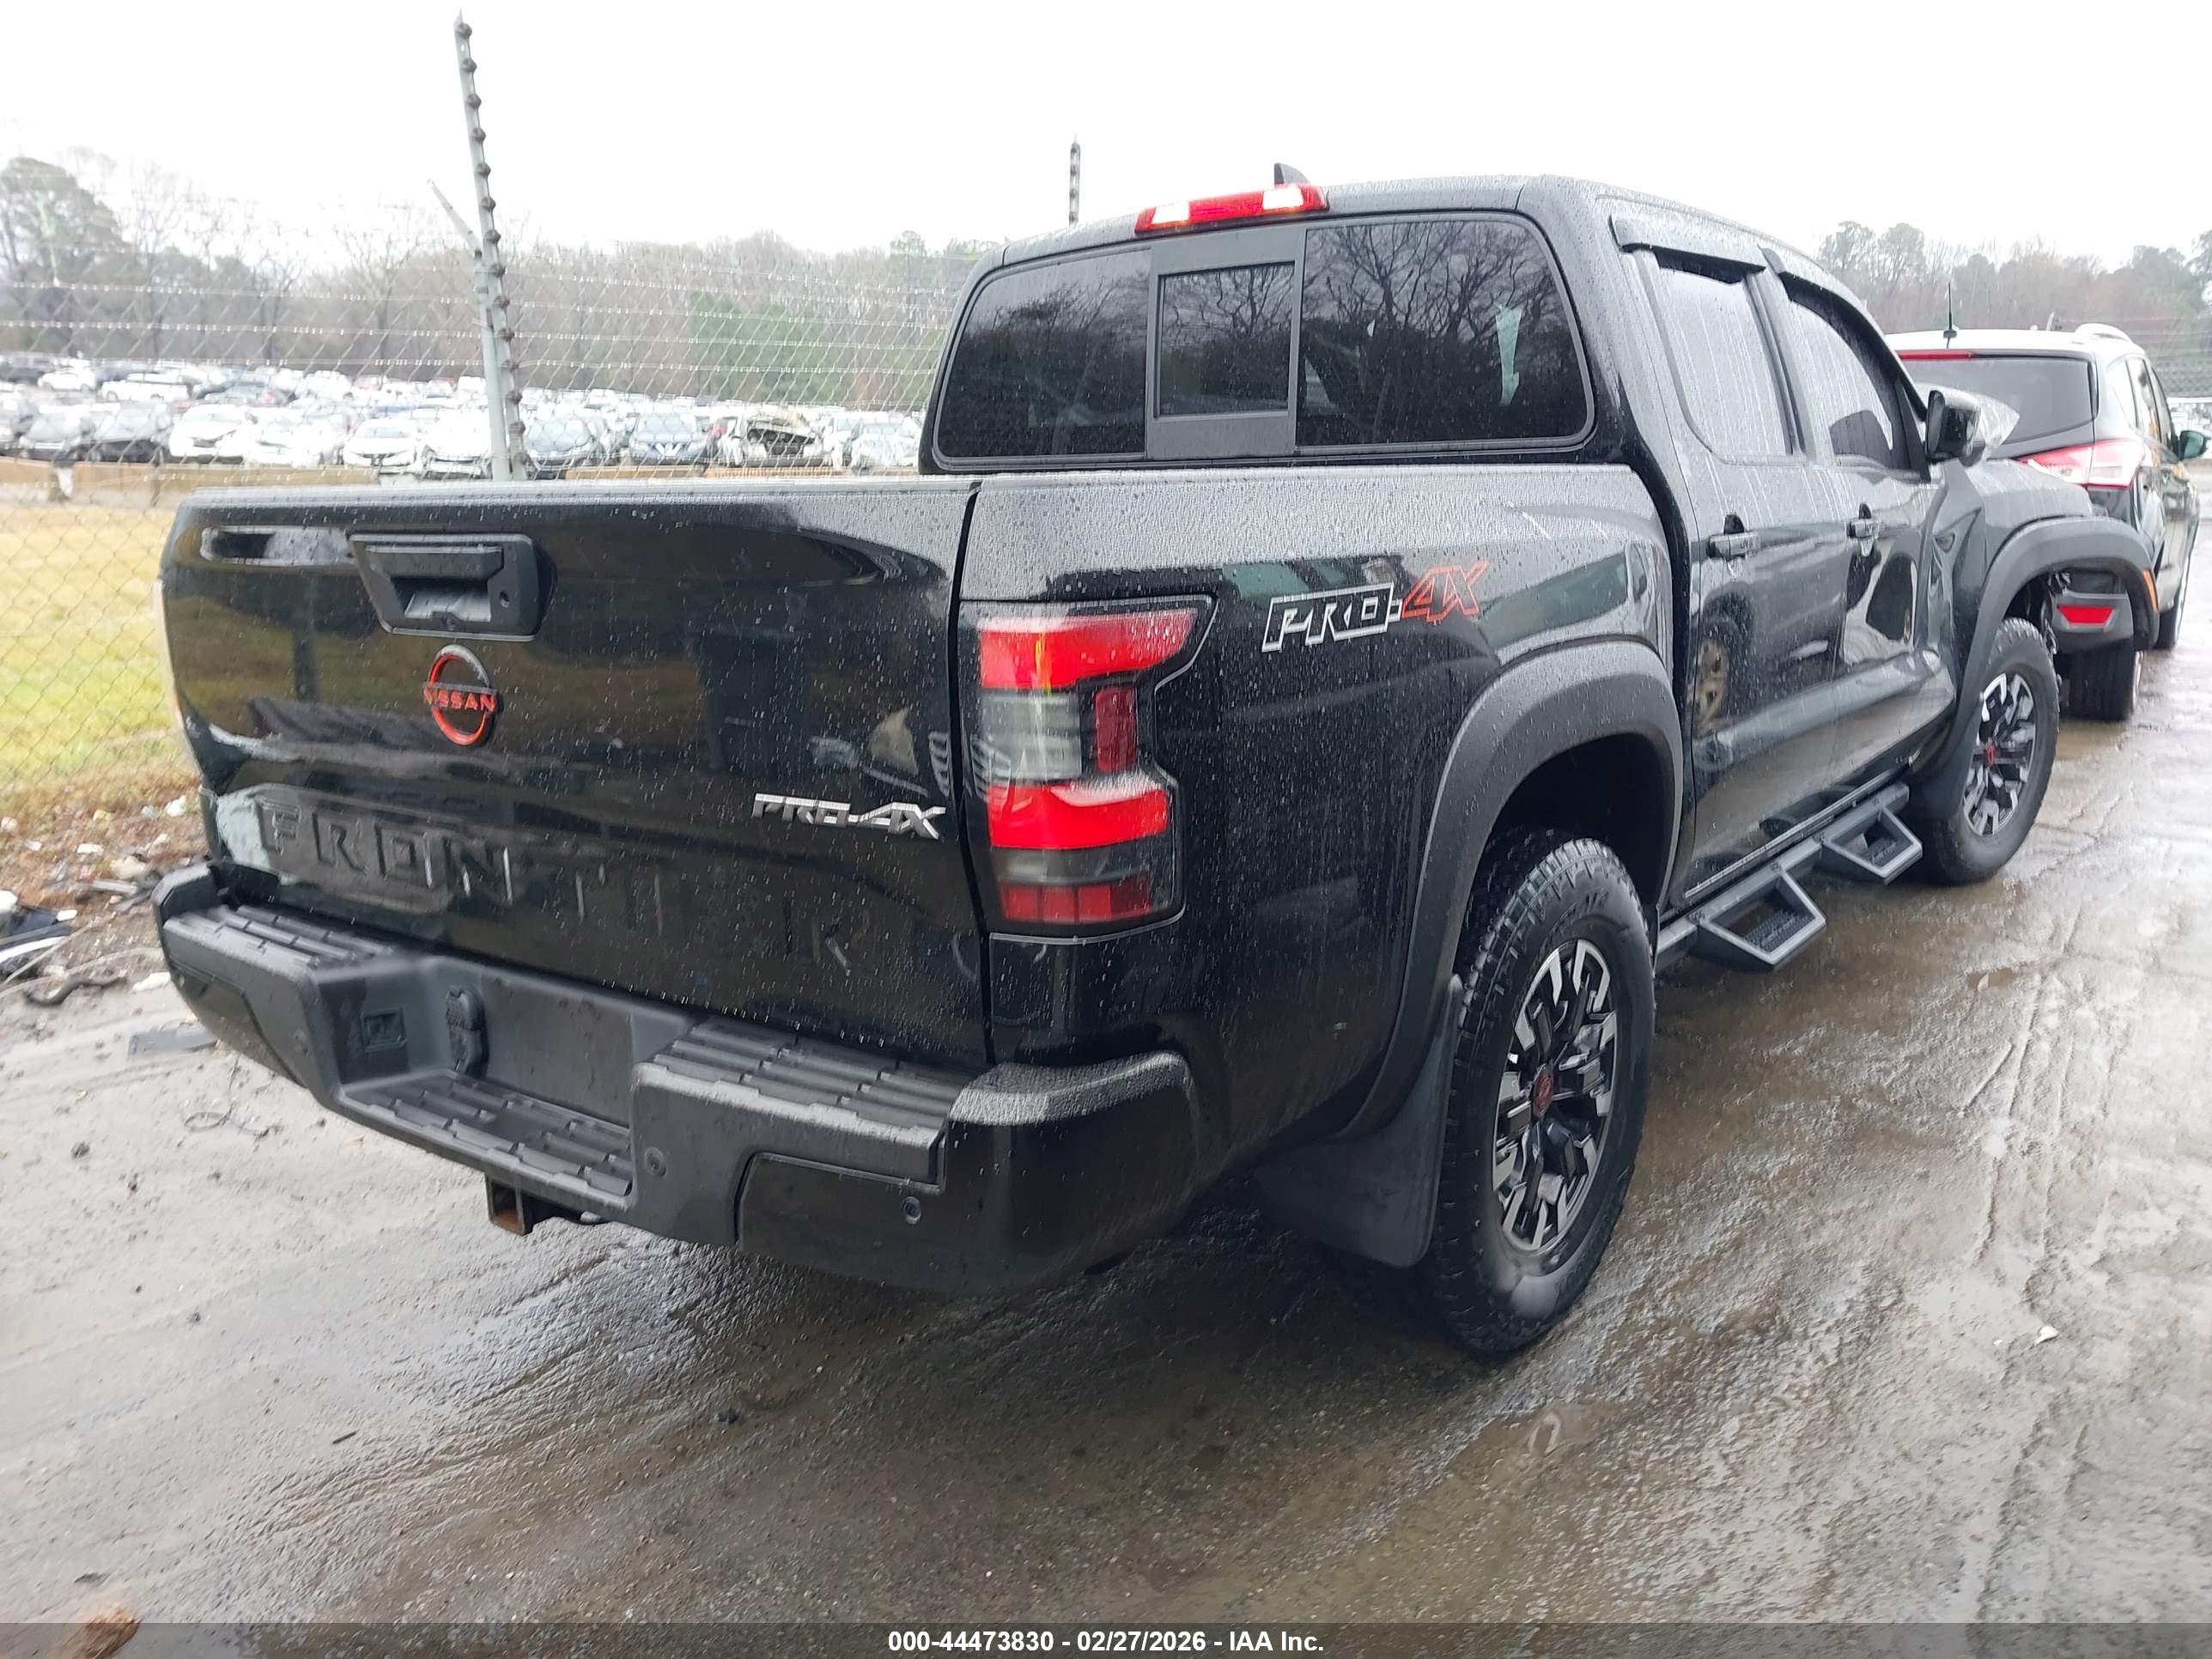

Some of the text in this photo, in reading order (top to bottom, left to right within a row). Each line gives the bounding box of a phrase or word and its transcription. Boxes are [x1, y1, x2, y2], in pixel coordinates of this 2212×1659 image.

[1261, 561, 1490, 653] PRO-4X
[422, 685, 496, 713] NISSAN
[751, 793, 947, 841] PRO-4X
[254, 798, 870, 975] FRONTIR
